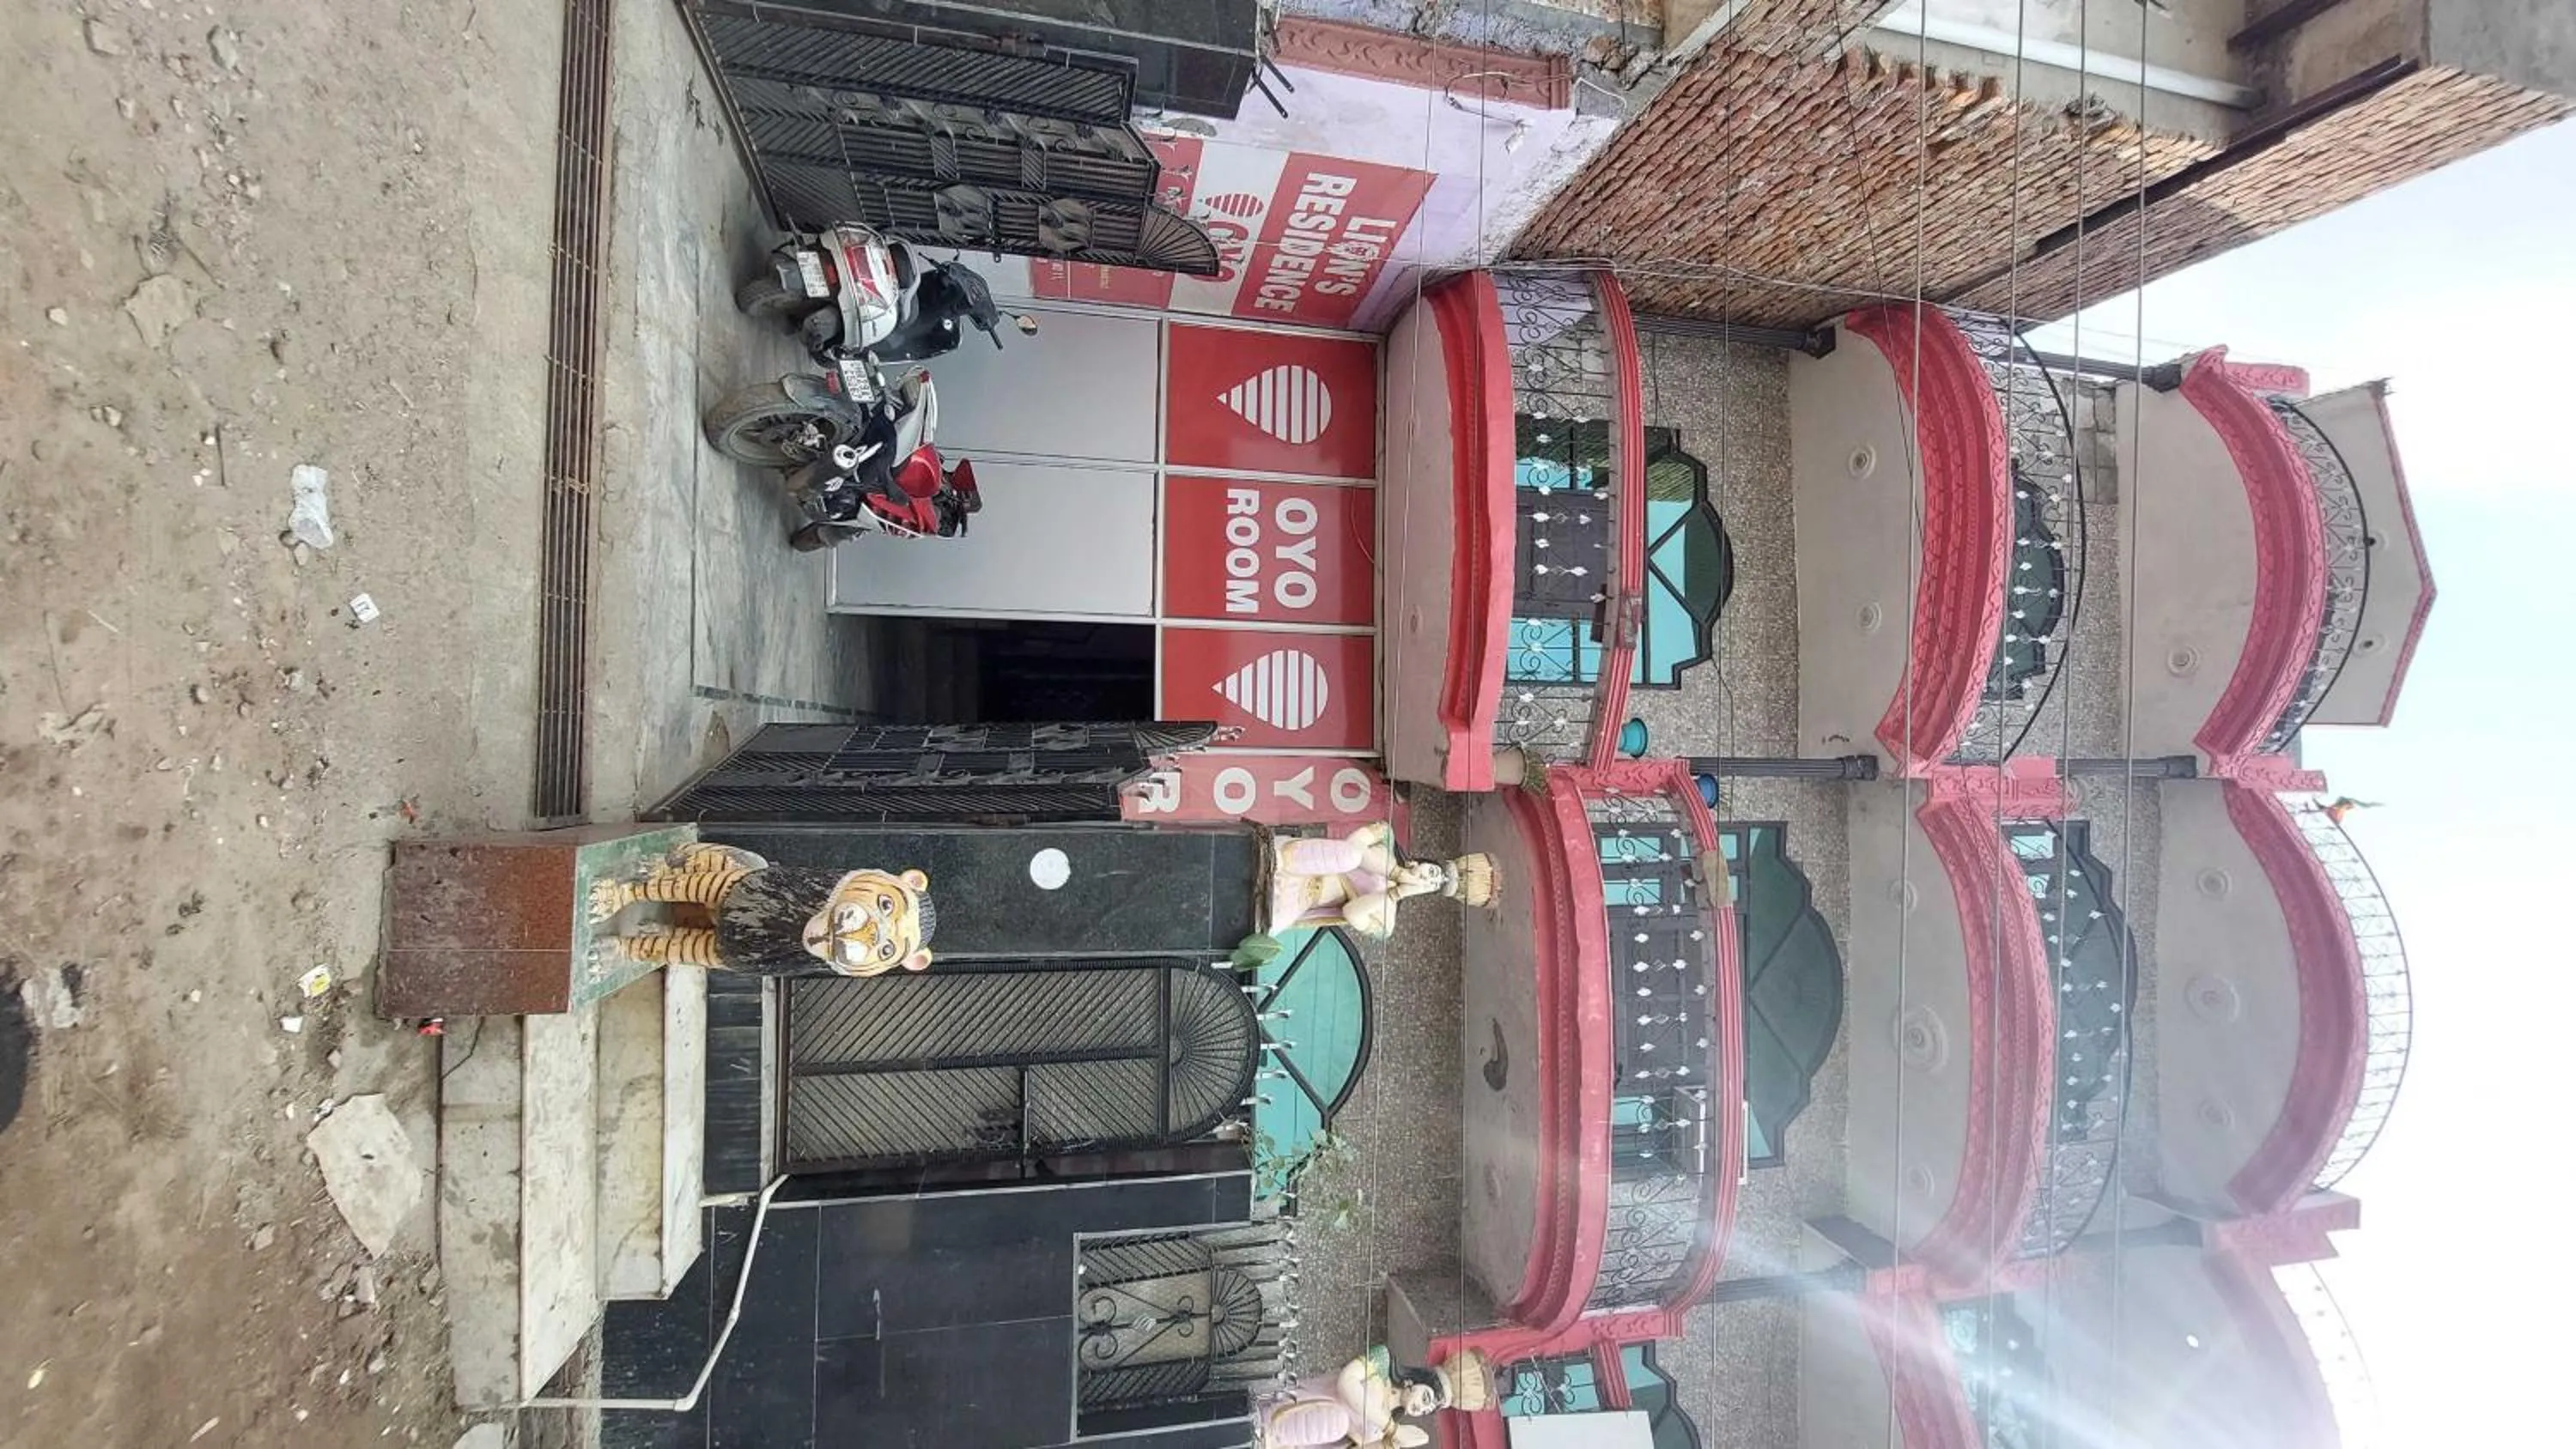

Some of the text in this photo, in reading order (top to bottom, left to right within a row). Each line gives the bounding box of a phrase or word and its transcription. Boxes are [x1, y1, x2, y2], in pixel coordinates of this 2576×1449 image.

[1255, 172, 1357, 313] RESIDENCE
[1315, 215, 1397, 296] LION'S
[1224, 488, 1260, 614] ROOM
[1274, 498, 1318, 609] OYO
[1213, 767, 1371, 815] OYO
